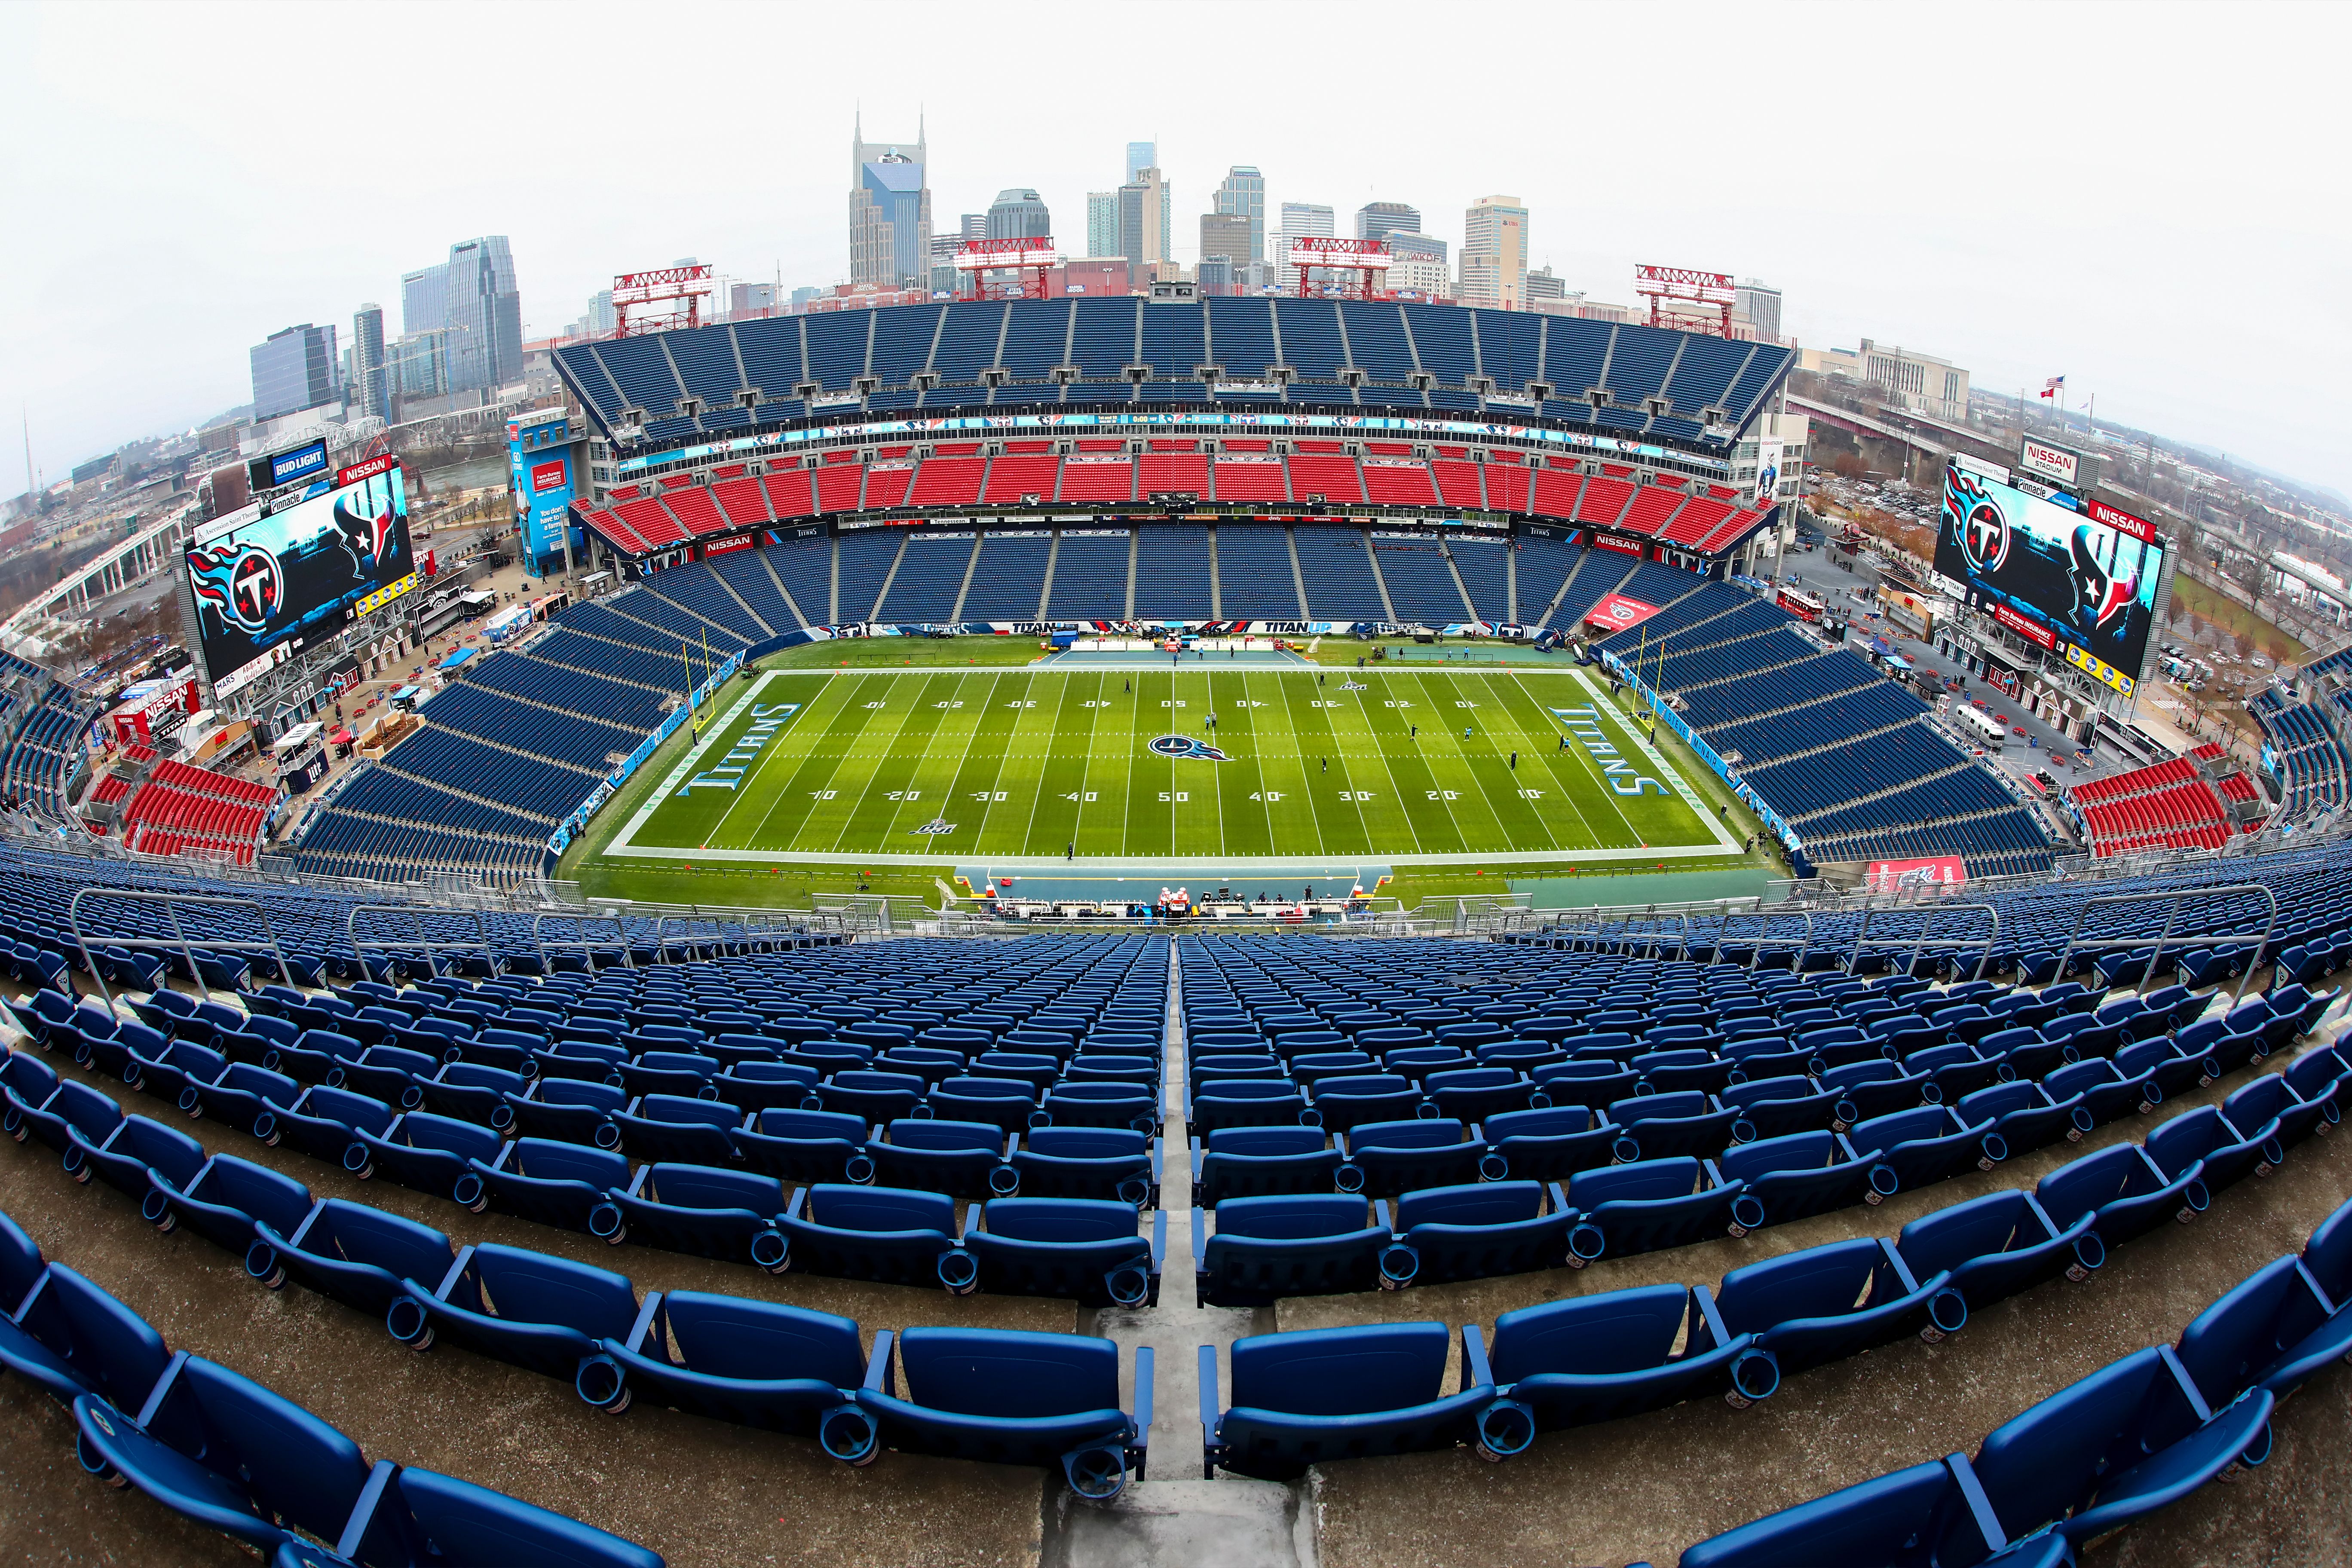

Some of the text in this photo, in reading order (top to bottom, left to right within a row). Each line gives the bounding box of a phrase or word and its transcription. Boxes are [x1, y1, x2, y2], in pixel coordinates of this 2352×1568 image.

[1411, 253, 1441, 262] WKDF
[513, 452, 520, 462] GO
[2027, 446, 2072, 469] NISSAN
[275, 451, 322, 476] BUD LIGHT
[346, 458, 386, 481] NISSAN
[1963, 459, 2008, 480] Ascension Saint Thomas
[2035, 460, 2062, 475] STADIUM
[537, 475, 561, 485] INSURANCE
[2019, 478, 2046, 497] Pinnacle
[273, 493, 300, 512] Pinnacle
[551, 505, 564, 514] don't
[205, 509, 260, 536] Ascension Saint Thomas
[2096, 505, 2146, 536] NISSAN
[797, 528, 816, 537] TITANS
[1530, 527, 1550, 536] TITANS
[707, 536, 750, 551] NISSAN
[1597, 535, 1639, 551] NISSAN
[1948, 580, 1959, 591] TITAN
[428, 594, 436, 607] JACK
[1616, 598, 1648, 611] NISSAN
[1592, 613, 1626, 627] NISSAN
[1593, 621, 1611, 630] NISSAN
[1999, 606, 2051, 640] Farm Bureau INSURANCE
[2070, 649, 2079, 660] Kroger
[2086, 659, 2096, 670] Kroger
[2103, 669, 2113, 680] Kroger
[216, 674, 235, 692] MARS
[2120, 679, 2131, 691] Kroger
[219, 686, 235, 698] Petcare
[144, 685, 188, 719] NISSAN
[161, 717, 185, 735] TITAN
[634, 707, 687, 764] EDDIE 27 GEORGE
[1668, 713, 1718, 767] STEVE 9 McNAIR
[675, 703, 802, 796] TITANS
[1547, 702, 1671, 796] TITANS
[308, 762, 322, 783] Lite
[813, 790, 839, 799] 10
[888, 791, 922, 800] 20
[976, 792, 1008, 802] 30
[1066, 792, 1098, 802] 40
[1158, 792, 1189, 802] 50
[1249, 791, 1280, 801] 40
[1338, 791, 1370, 801] 30
[1425, 790, 1457, 800] 20
[1517, 789, 1540, 799] 10
[609, 1402, 626, 1414] Coca-Cola
